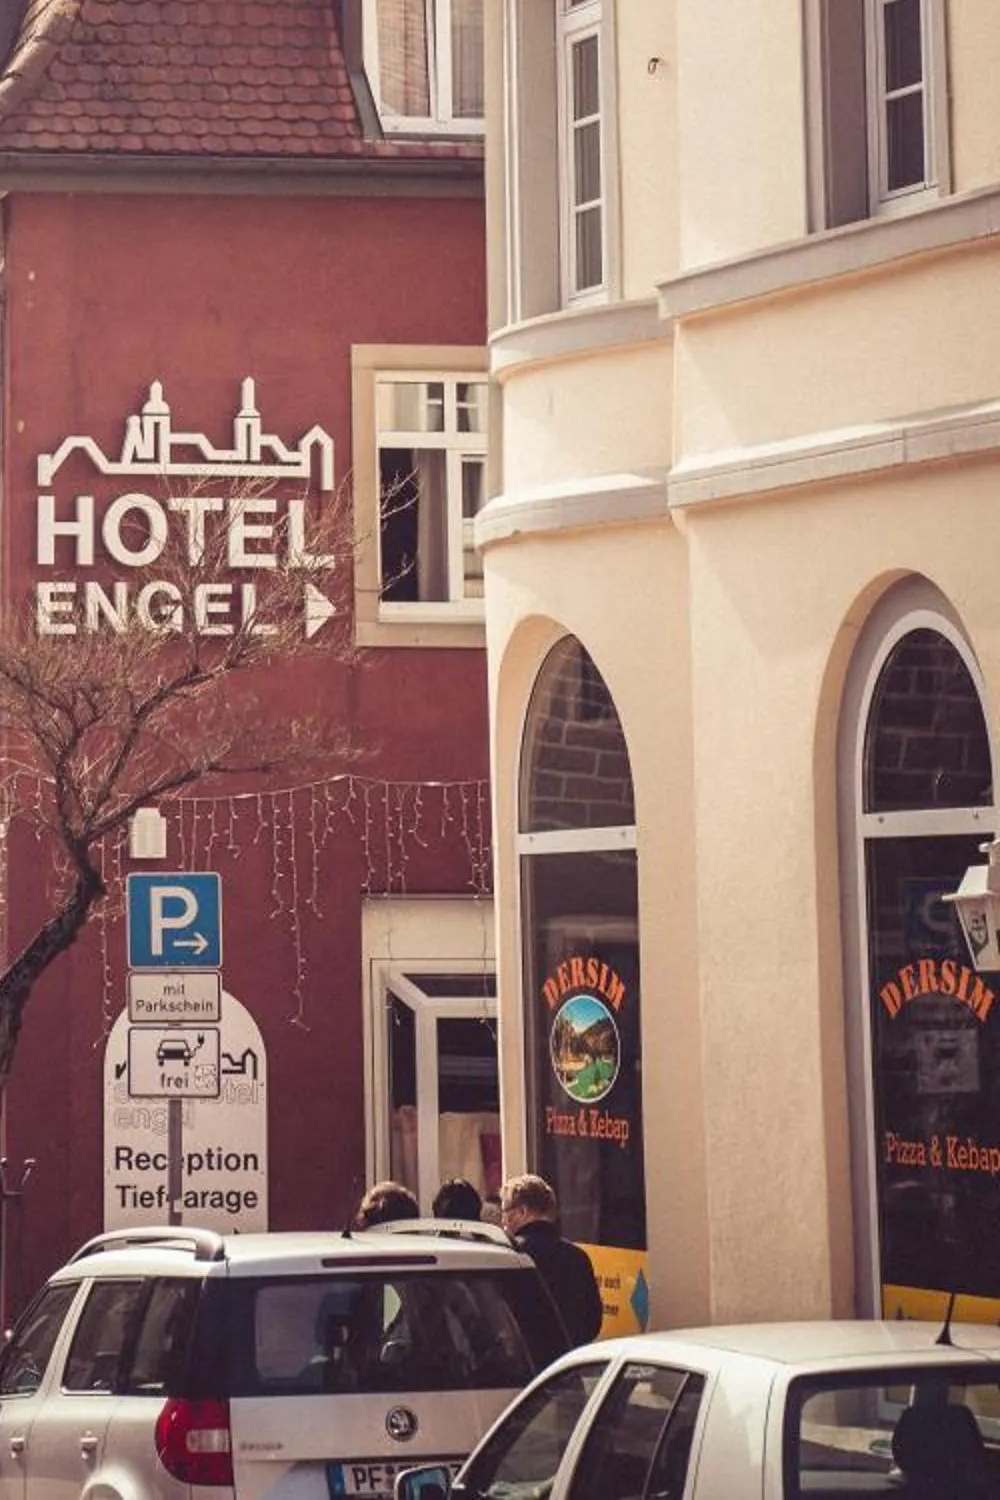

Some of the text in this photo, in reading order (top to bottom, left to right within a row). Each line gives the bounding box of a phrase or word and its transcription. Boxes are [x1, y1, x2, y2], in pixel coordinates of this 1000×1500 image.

[37, 493, 335, 569] HOTEL
[36, 580, 280, 636] ENGEL
[150, 886, 199, 955] P
[163, 983, 185, 996] mit
[543, 957, 625, 1011] DERSIM
[880, 959, 995, 1021] DERSIM
[136, 999, 213, 1012] Parkschein
[161, 1071, 189, 1089] frei
[577, 1108, 588, 1137] &
[589, 1108, 629, 1148] Kebap
[115, 1145, 259, 1175] Recption
[885, 1132, 1000, 1176] Pizza & Kebap
[115, 1185, 258, 1214] Tiefarage
